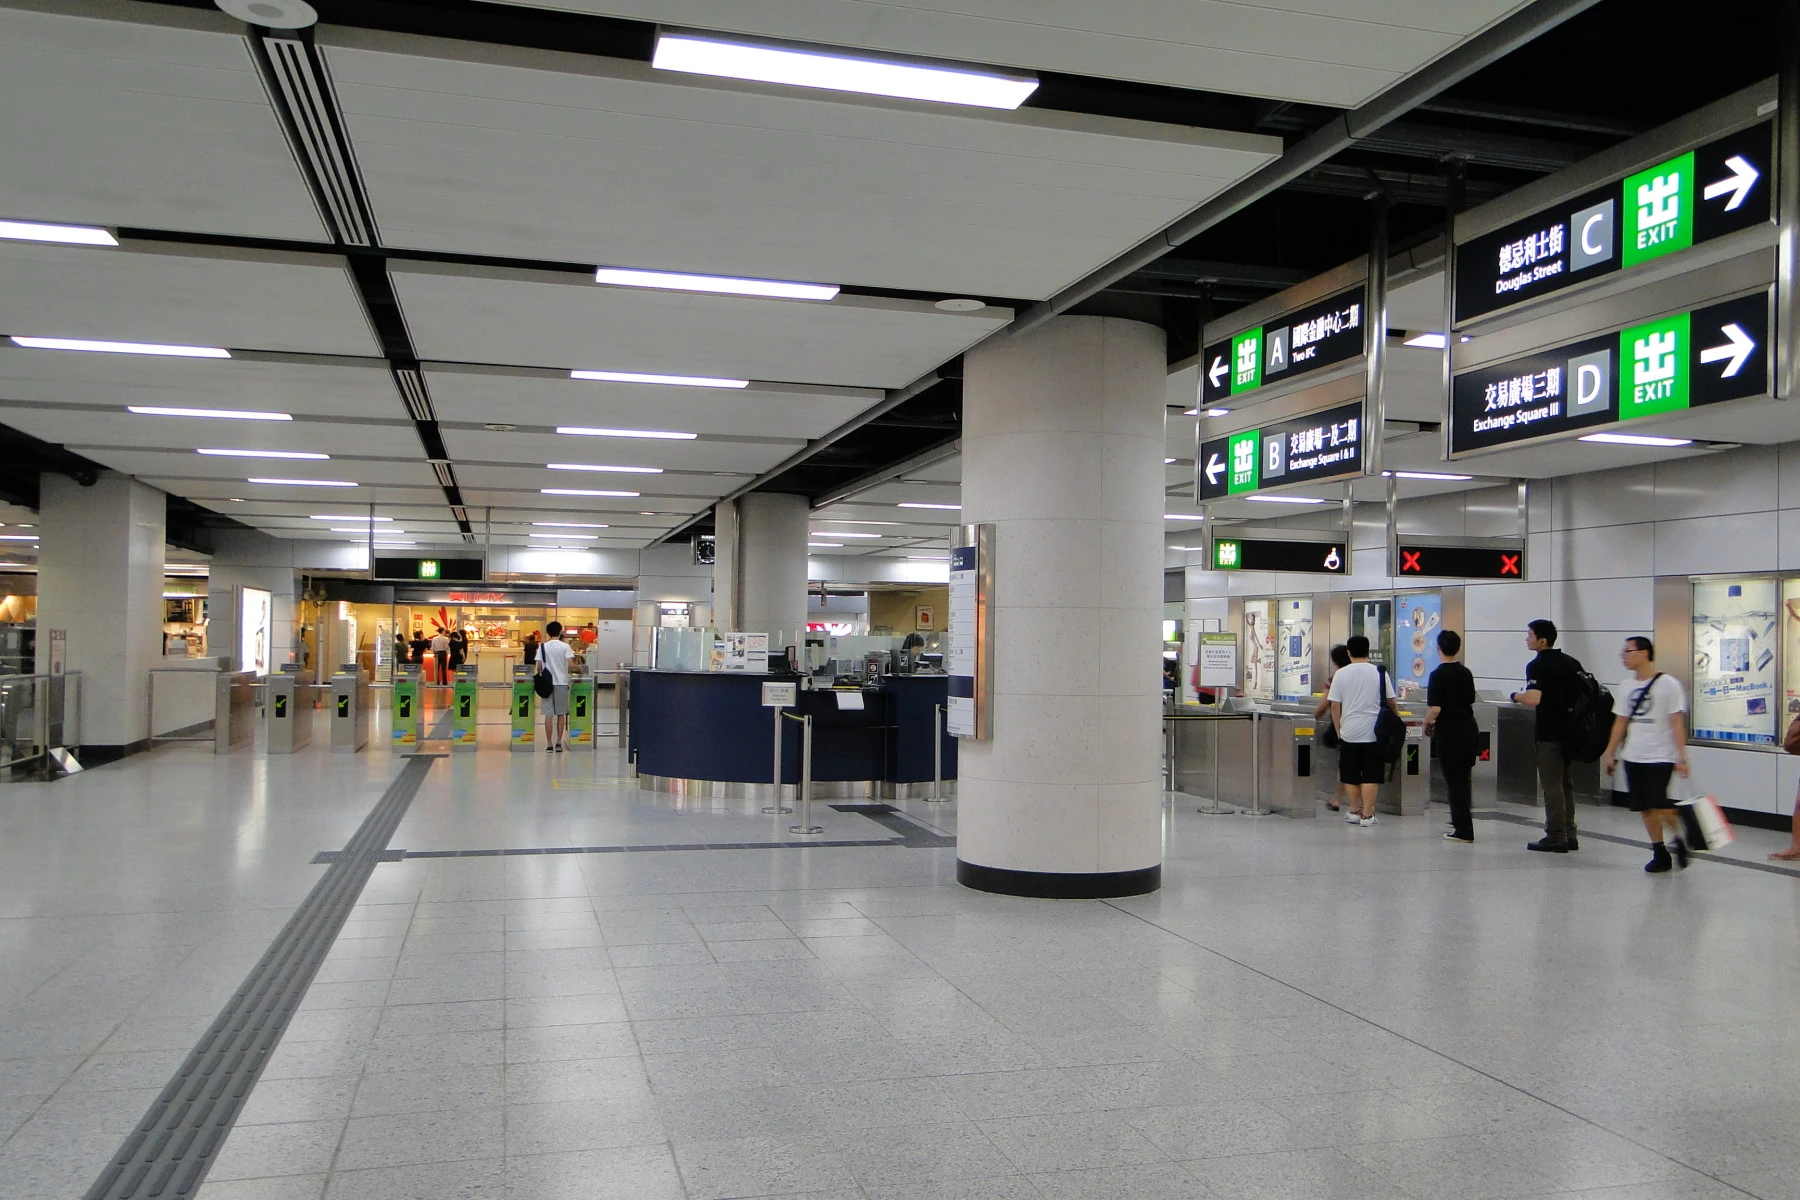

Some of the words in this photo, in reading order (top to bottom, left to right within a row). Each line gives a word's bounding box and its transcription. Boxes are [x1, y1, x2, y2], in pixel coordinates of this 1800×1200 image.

[1499, 224, 1563, 274] 德忌利士街
[1581, 213, 1603, 256] C
[1637, 221, 1678, 250] EXIT
[1495, 272, 1532, 294] Douglas
[1533, 260, 1562, 282] Street
[1292, 304, 1360, 349] 國際金融中心二期
[1270, 336, 1284, 367] A
[1292, 352, 1305, 363] Two
[1305, 346, 1316, 359] IFC
[1237, 369, 1256, 386] EXIT
[1484, 366, 1560, 412] 交易廣場三期
[1577, 364, 1601, 405] D
[1634, 380, 1674, 404] EXIT
[1473, 413, 1515, 433] Exchange
[1516, 407, 1548, 427] Square
[1550, 402, 1559, 416] III
[1290, 418, 1358, 456] 交易廣場一及二期
[1269, 441, 1280, 471] B
[1289, 457, 1318, 471] Exchange
[1318, 452, 1340, 466] Square
[1234, 471, 1253, 486] EXIT
[1219, 558, 1236, 566] EXIT
[1735, 682, 1768, 692] MacBook
